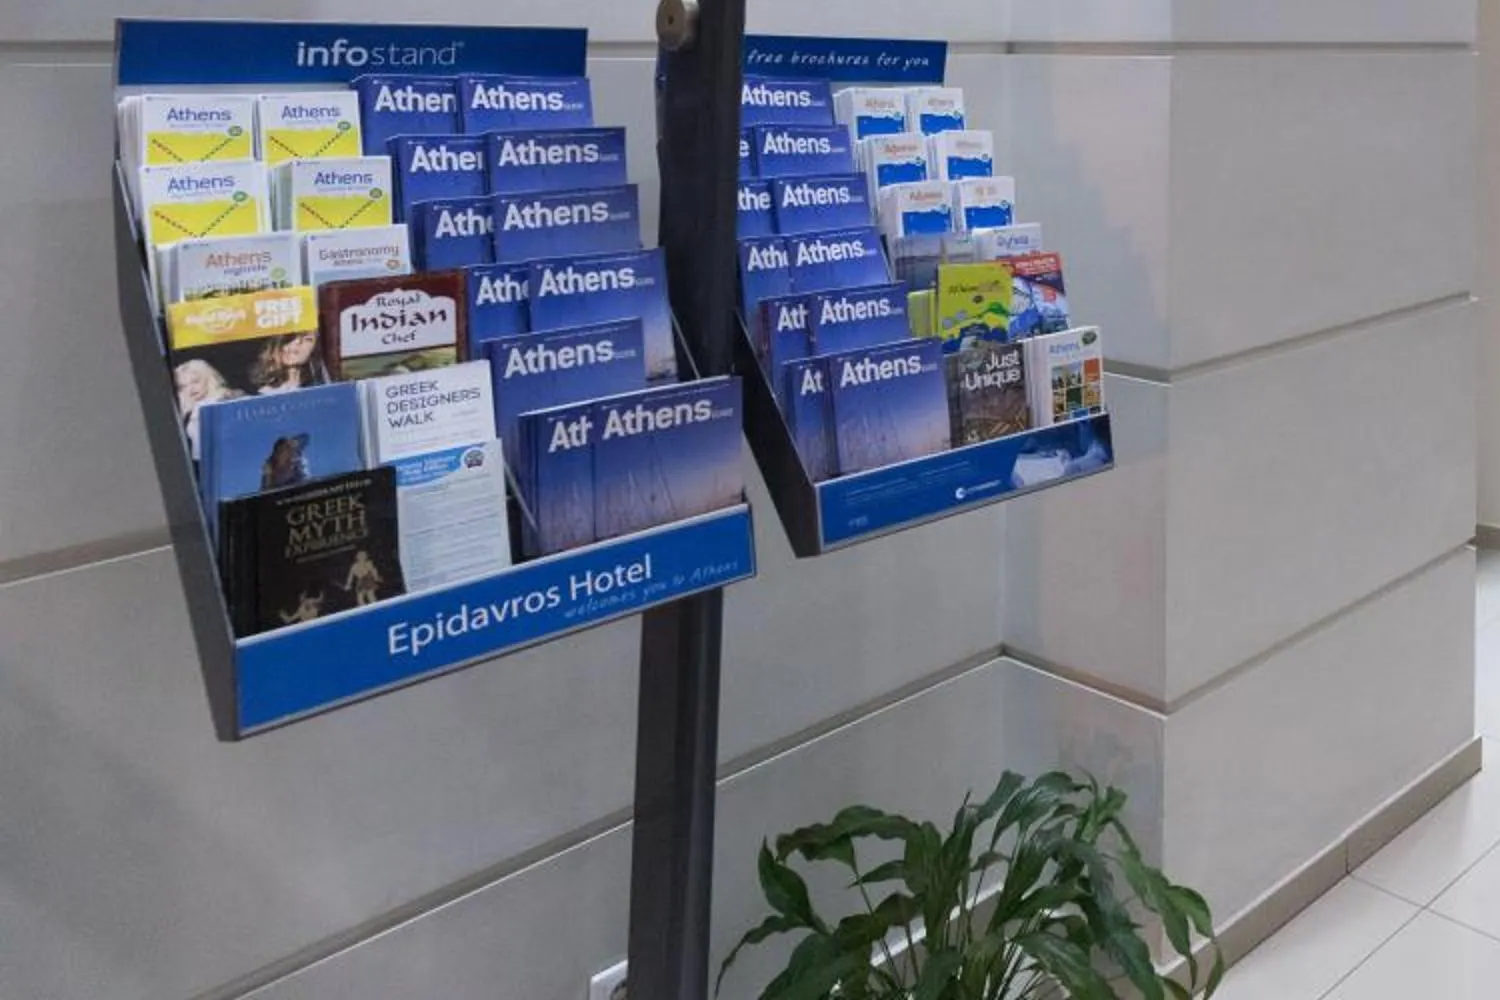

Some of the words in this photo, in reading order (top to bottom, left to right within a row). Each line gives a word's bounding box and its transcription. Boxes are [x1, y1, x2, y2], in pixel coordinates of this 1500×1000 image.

[297, 40, 456, 67] infostand
[374, 85, 457, 113] Athen
[471, 83, 564, 112] Athens
[741, 84, 812, 107] Athens
[167, 107, 232, 121] Athens
[281, 105, 341, 120] Athens
[498, 139, 600, 167] Athens
[763, 131, 831, 155] Athens
[167, 175, 237, 194] Athens
[313, 171, 374, 185] Athens
[782, 183, 850, 208] Athens
[503, 200, 610, 231] Athens
[205, 251, 272, 268] Athens
[319, 245, 400, 261] Gastronomy
[796, 239, 865, 267] Athens
[538, 265, 636, 298] Athens
[376, 293, 421, 308] Royal
[820, 297, 891, 325] Athens
[351, 308, 448, 333] Indian
[381, 330, 418, 345] Chef
[503, 339, 614, 379] Athens
[986, 350, 1021, 371] Just
[840, 355, 921, 389] Athens
[964, 367, 1022, 391] Unique
[385, 380, 440, 399] GREEK
[386, 387, 481, 415] DESIGNERS
[387, 411, 434, 428] WALK
[602, 399, 713, 440] Athens
[286, 493, 365, 526] GREEK
[287, 508, 366, 547] MYTH
[387, 584, 561, 656] Epidavros
[569, 552, 653, 602] Hotel
